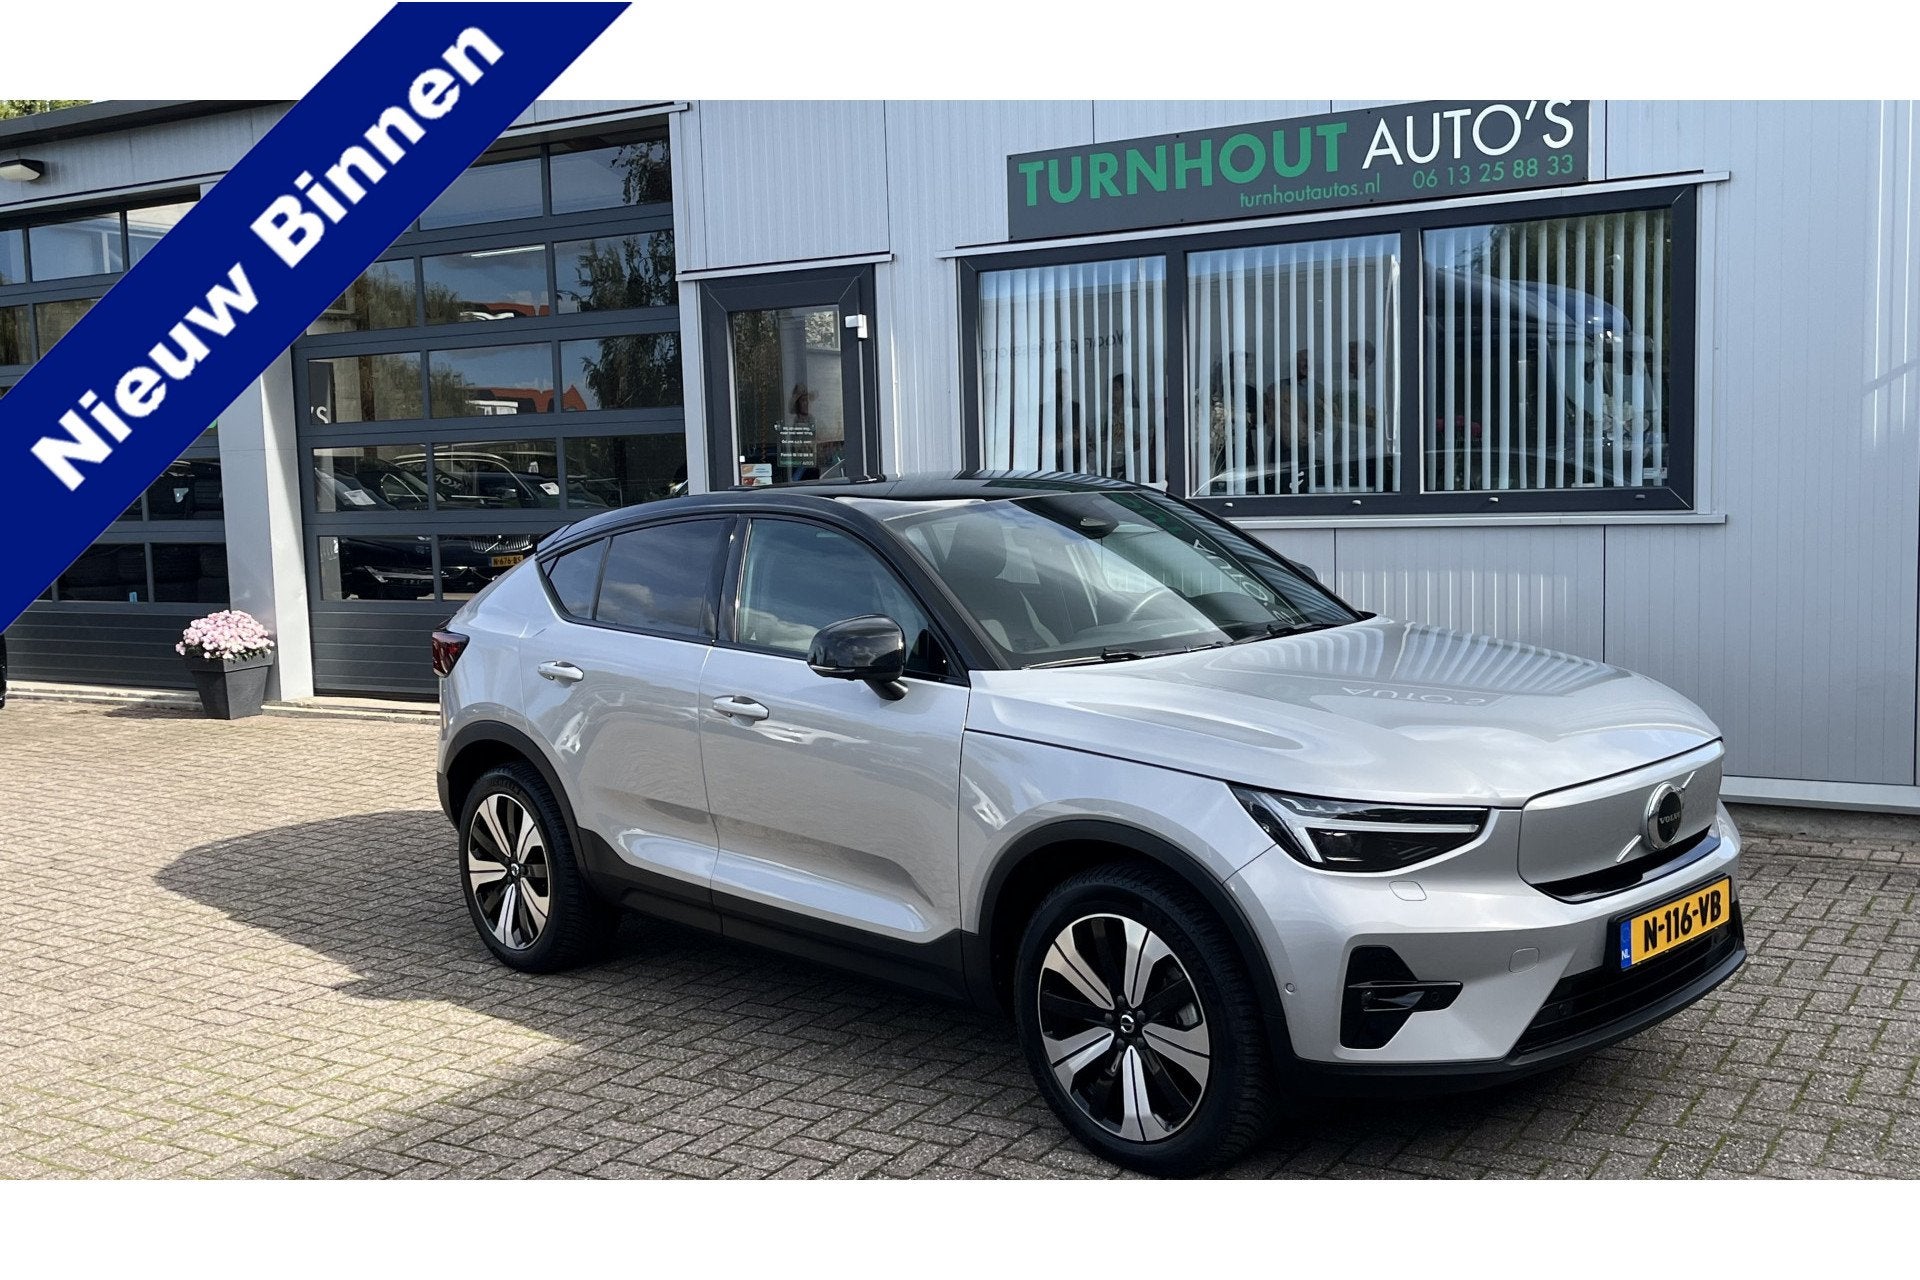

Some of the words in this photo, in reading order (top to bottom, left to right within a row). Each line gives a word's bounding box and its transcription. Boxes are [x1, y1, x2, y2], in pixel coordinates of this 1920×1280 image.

[1018, 122, 1347, 206] TURNHOUT
[1361, 100, 1574, 170] AUTO'S
[1412, 169, 1438, 189] 06
[1448, 165, 1470, 185] 13
[1479, 162, 1504, 182] 25
[1512, 158, 1538, 178] 88
[1547, 154, 1573, 175] 33
[1240, 172, 1381, 208] turnhoutautos.nl
[1644, 889, 1722, 953] N-116-VB
[1621, 948, 1630, 960] NL
